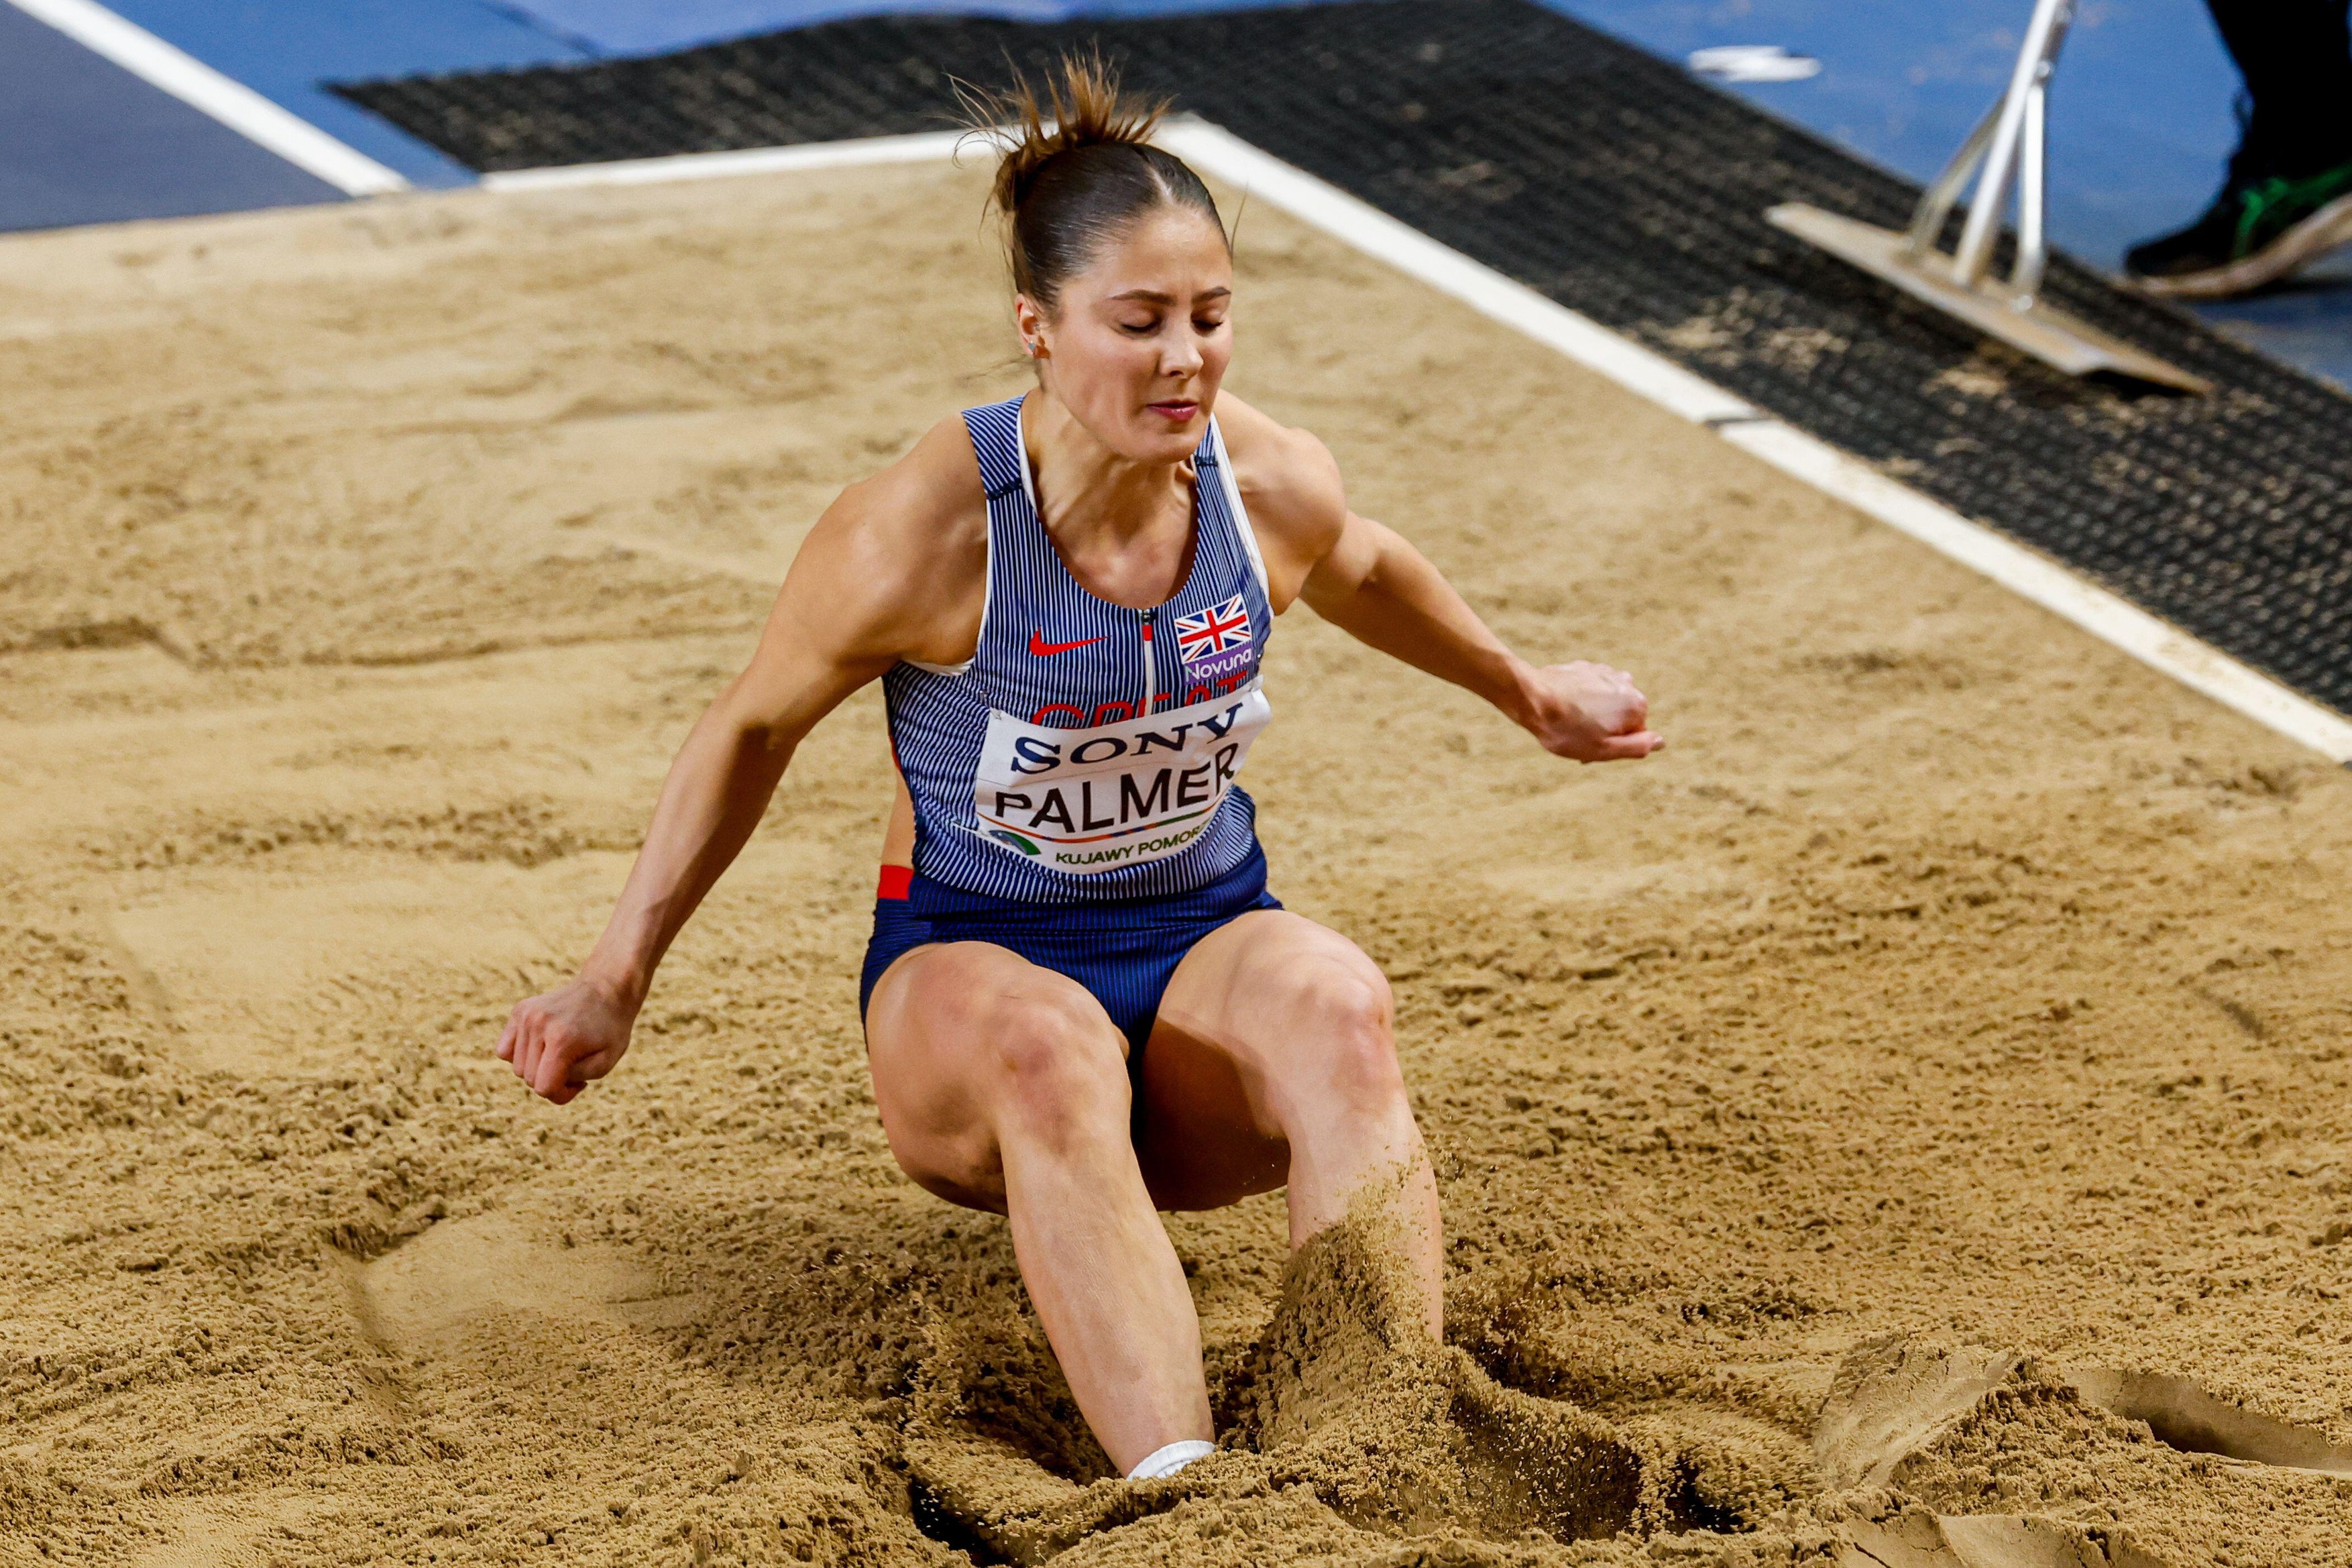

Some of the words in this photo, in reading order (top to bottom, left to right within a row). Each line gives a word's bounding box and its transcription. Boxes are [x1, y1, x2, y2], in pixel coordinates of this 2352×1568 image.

[1184, 648, 1253, 681] Novuna
[1011, 704, 1243, 774] SONY
[995, 742, 1239, 833] PALMER
[1056, 846, 1134, 864] KUJAWY
[1138, 818, 1211, 855] POMOR
